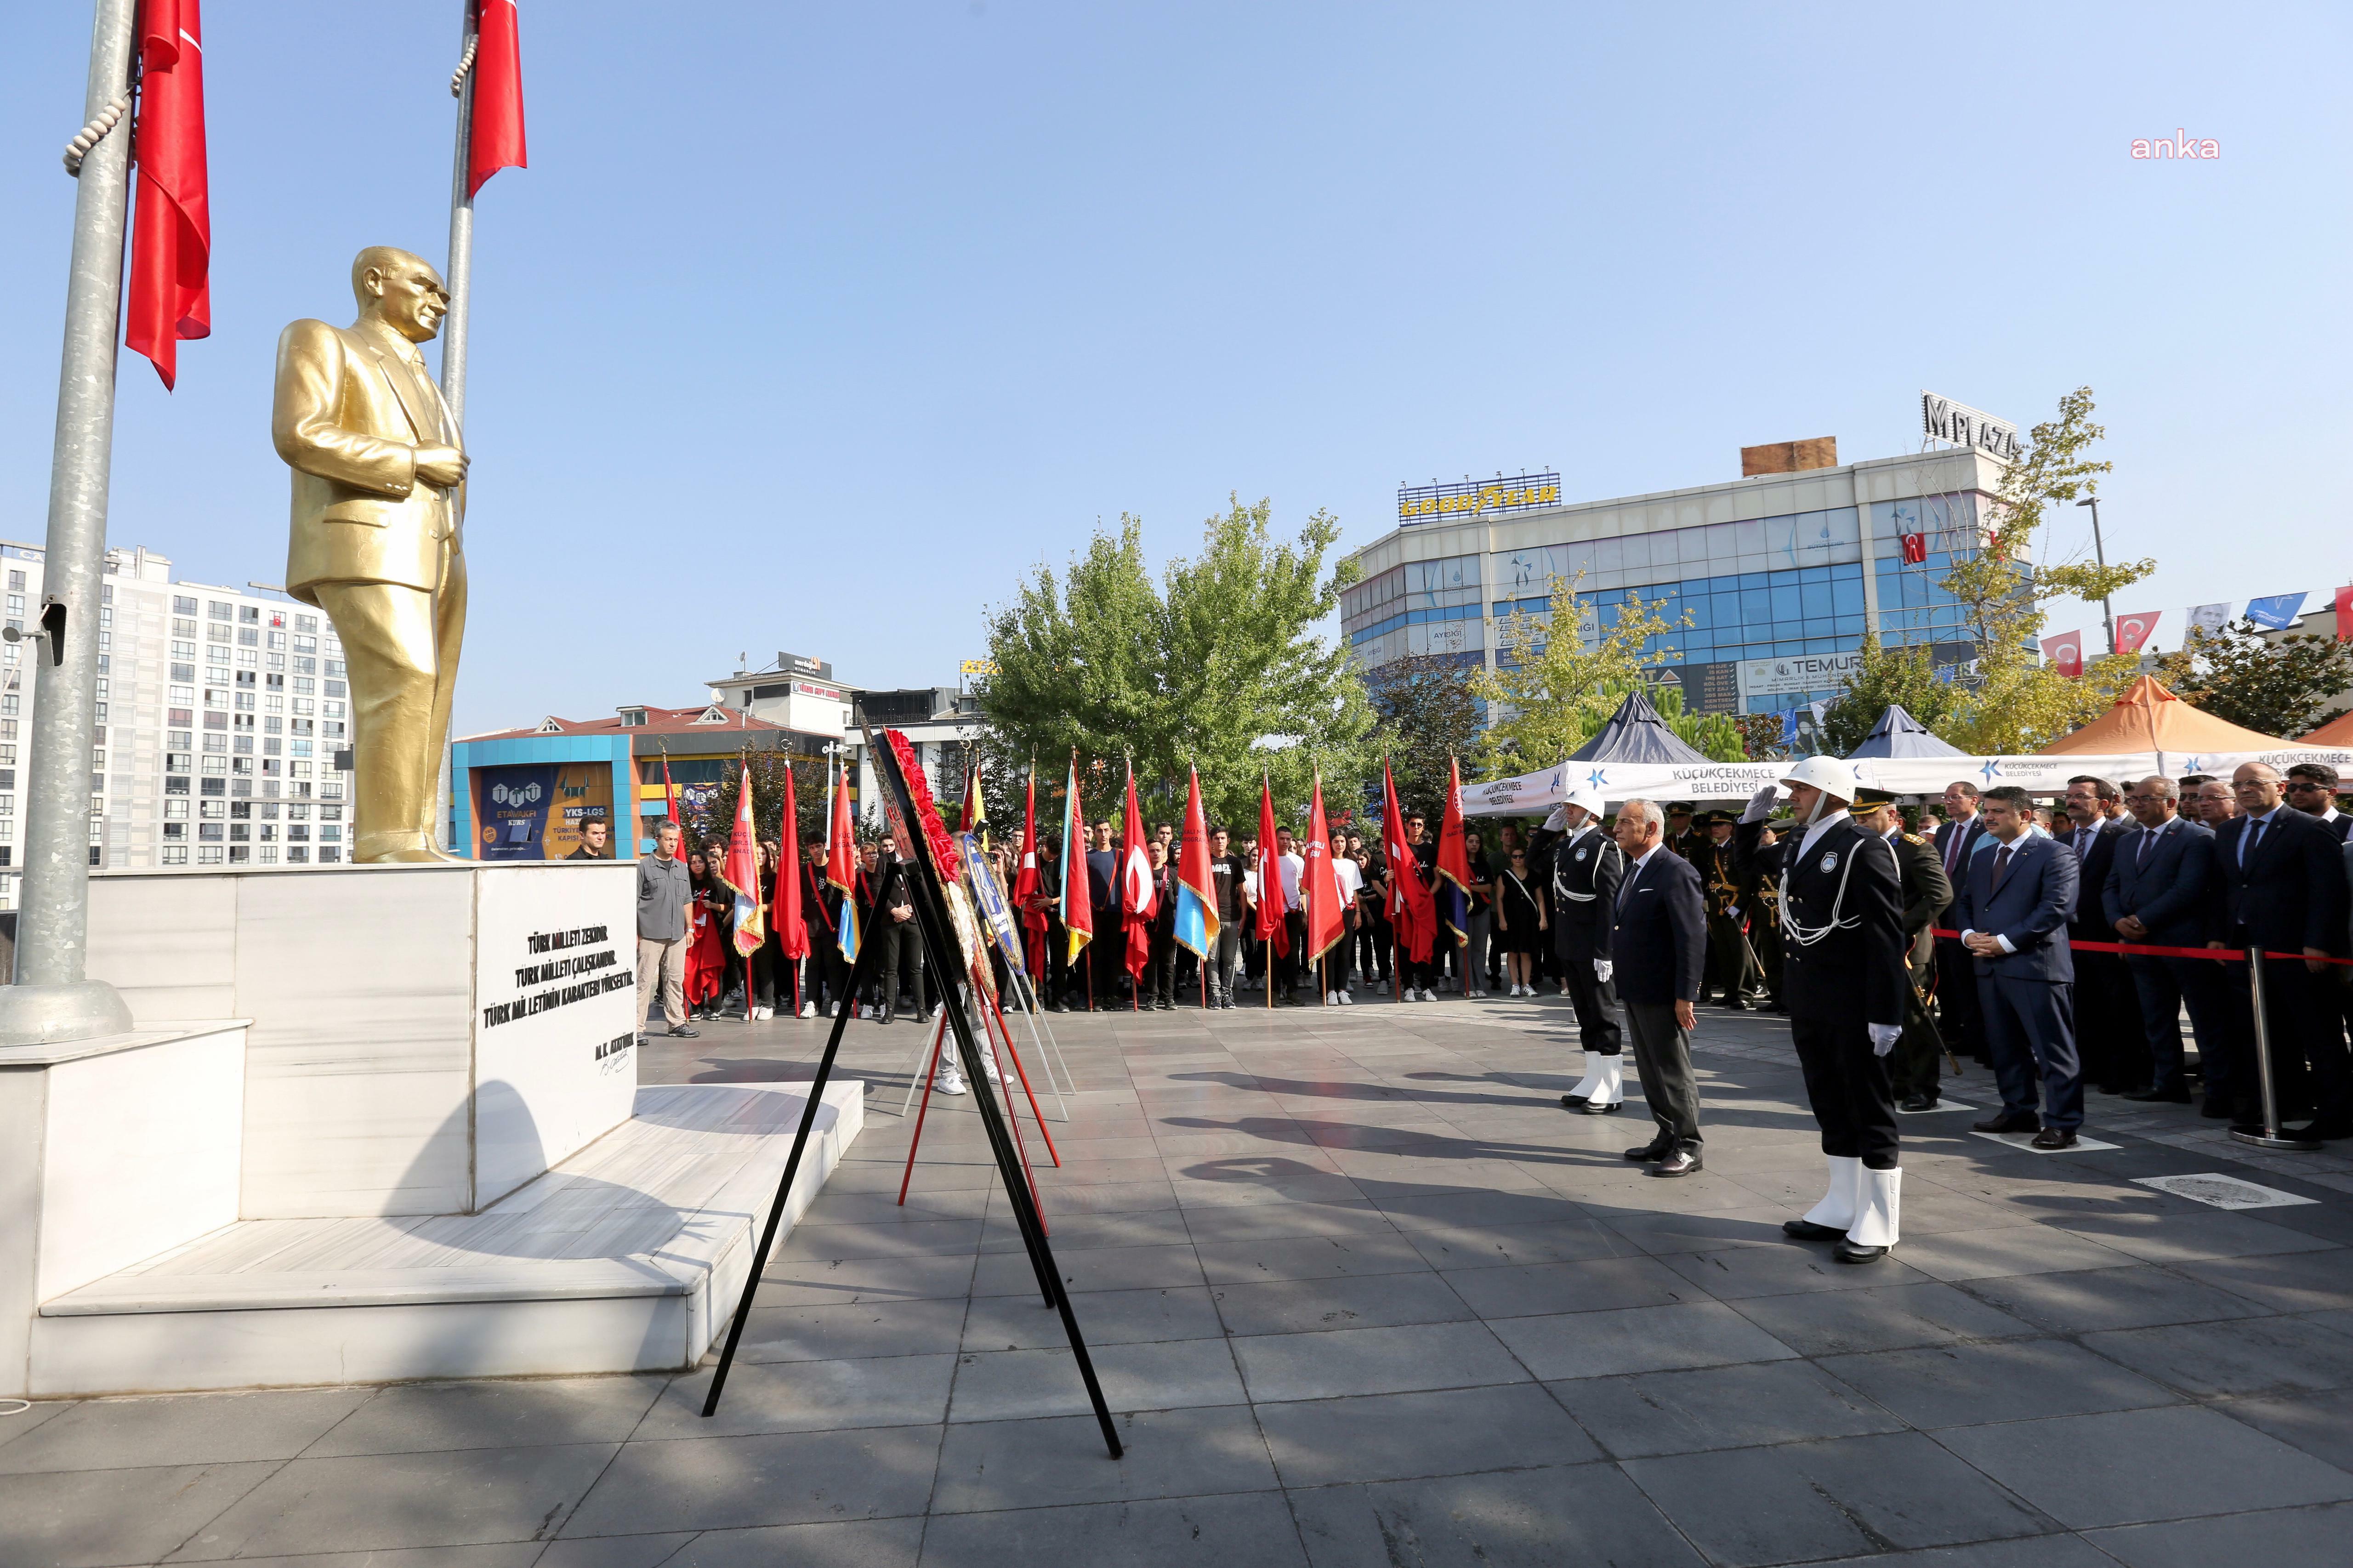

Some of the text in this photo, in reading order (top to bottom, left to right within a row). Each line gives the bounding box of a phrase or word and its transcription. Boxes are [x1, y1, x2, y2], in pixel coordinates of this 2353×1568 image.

[1953, 412, 2019, 460] PLAZA
[2259, 752, 2351, 765] KÜÇÜKÇEKMECE
[1673, 767, 1775, 780] KÜÇÜKÇEKMECE
[1482, 781, 1523, 795] KÜÇÜKÇEKMECE
[1692, 780, 1759, 793] BELEDİYESİ
[1489, 792, 1515, 806] BELEDİYESİ
[565, 807, 605, 817] YKS-LGS
[528, 931, 551, 954] TÜRK
[551, 926, 580, 951] MİLLETİ
[515, 950, 617, 988] TÜRK MİLLETİ ÇALIŞKANDIR.
[483, 1002, 511, 1029] TÜRK
[562, 976, 600, 1006] KARAKTERİ
[601, 968, 634, 994] YÜKSEKTİR.
[610, 1031, 634, 1055] ATATÜRK
